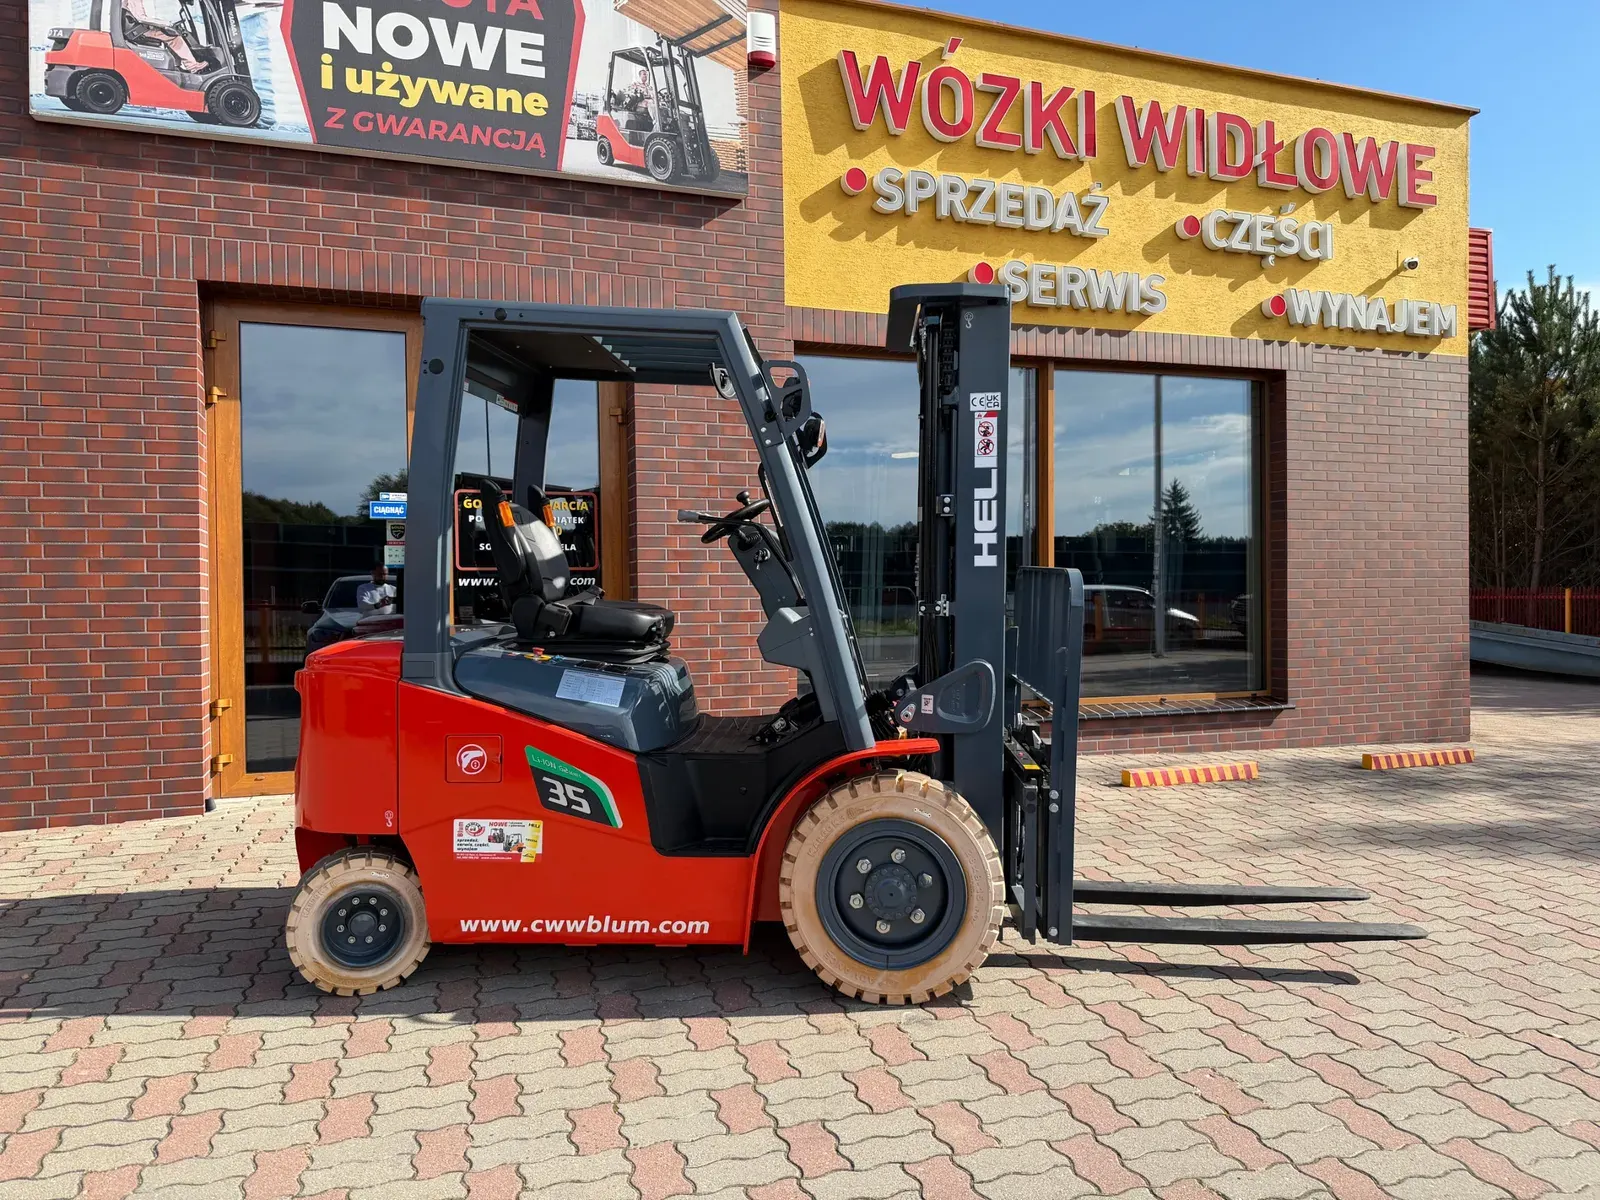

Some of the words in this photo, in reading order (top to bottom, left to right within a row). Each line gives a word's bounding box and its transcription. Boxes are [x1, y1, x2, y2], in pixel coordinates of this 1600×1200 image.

[322, 1, 546, 79] NOWE
[320, 53, 334, 90] i
[345, 61, 549, 117] używane
[324, 106, 347, 130] Z
[352, 111, 547, 158] GWARANCJĄ
[838, 37, 1097, 161] WÓZKI
[1114, 95, 1439, 209] WIDŁOWE
[873, 166, 1110, 239] SPRZEDAŻ
[1201, 202, 1333, 268] CZĘŚCI
[998, 259, 1167, 315] SERWIS
[1284, 287, 1458, 339] WYNAJEM
[971, 397, 985, 407] CE
[373, 505, 405, 516] CIĄGNĄĆ
[463, 499, 482, 509] GO
[468, 515, 484, 523] PO
[974, 456, 998, 567] HELI
[479, 543, 492, 551] SO
[561, 543, 577, 551] ELA
[458, 578, 500, 587] www.
[569, 577, 596, 586] com
[542, 776, 591, 815] 35
[460, 915, 710, 934] www.cwwblum.com
